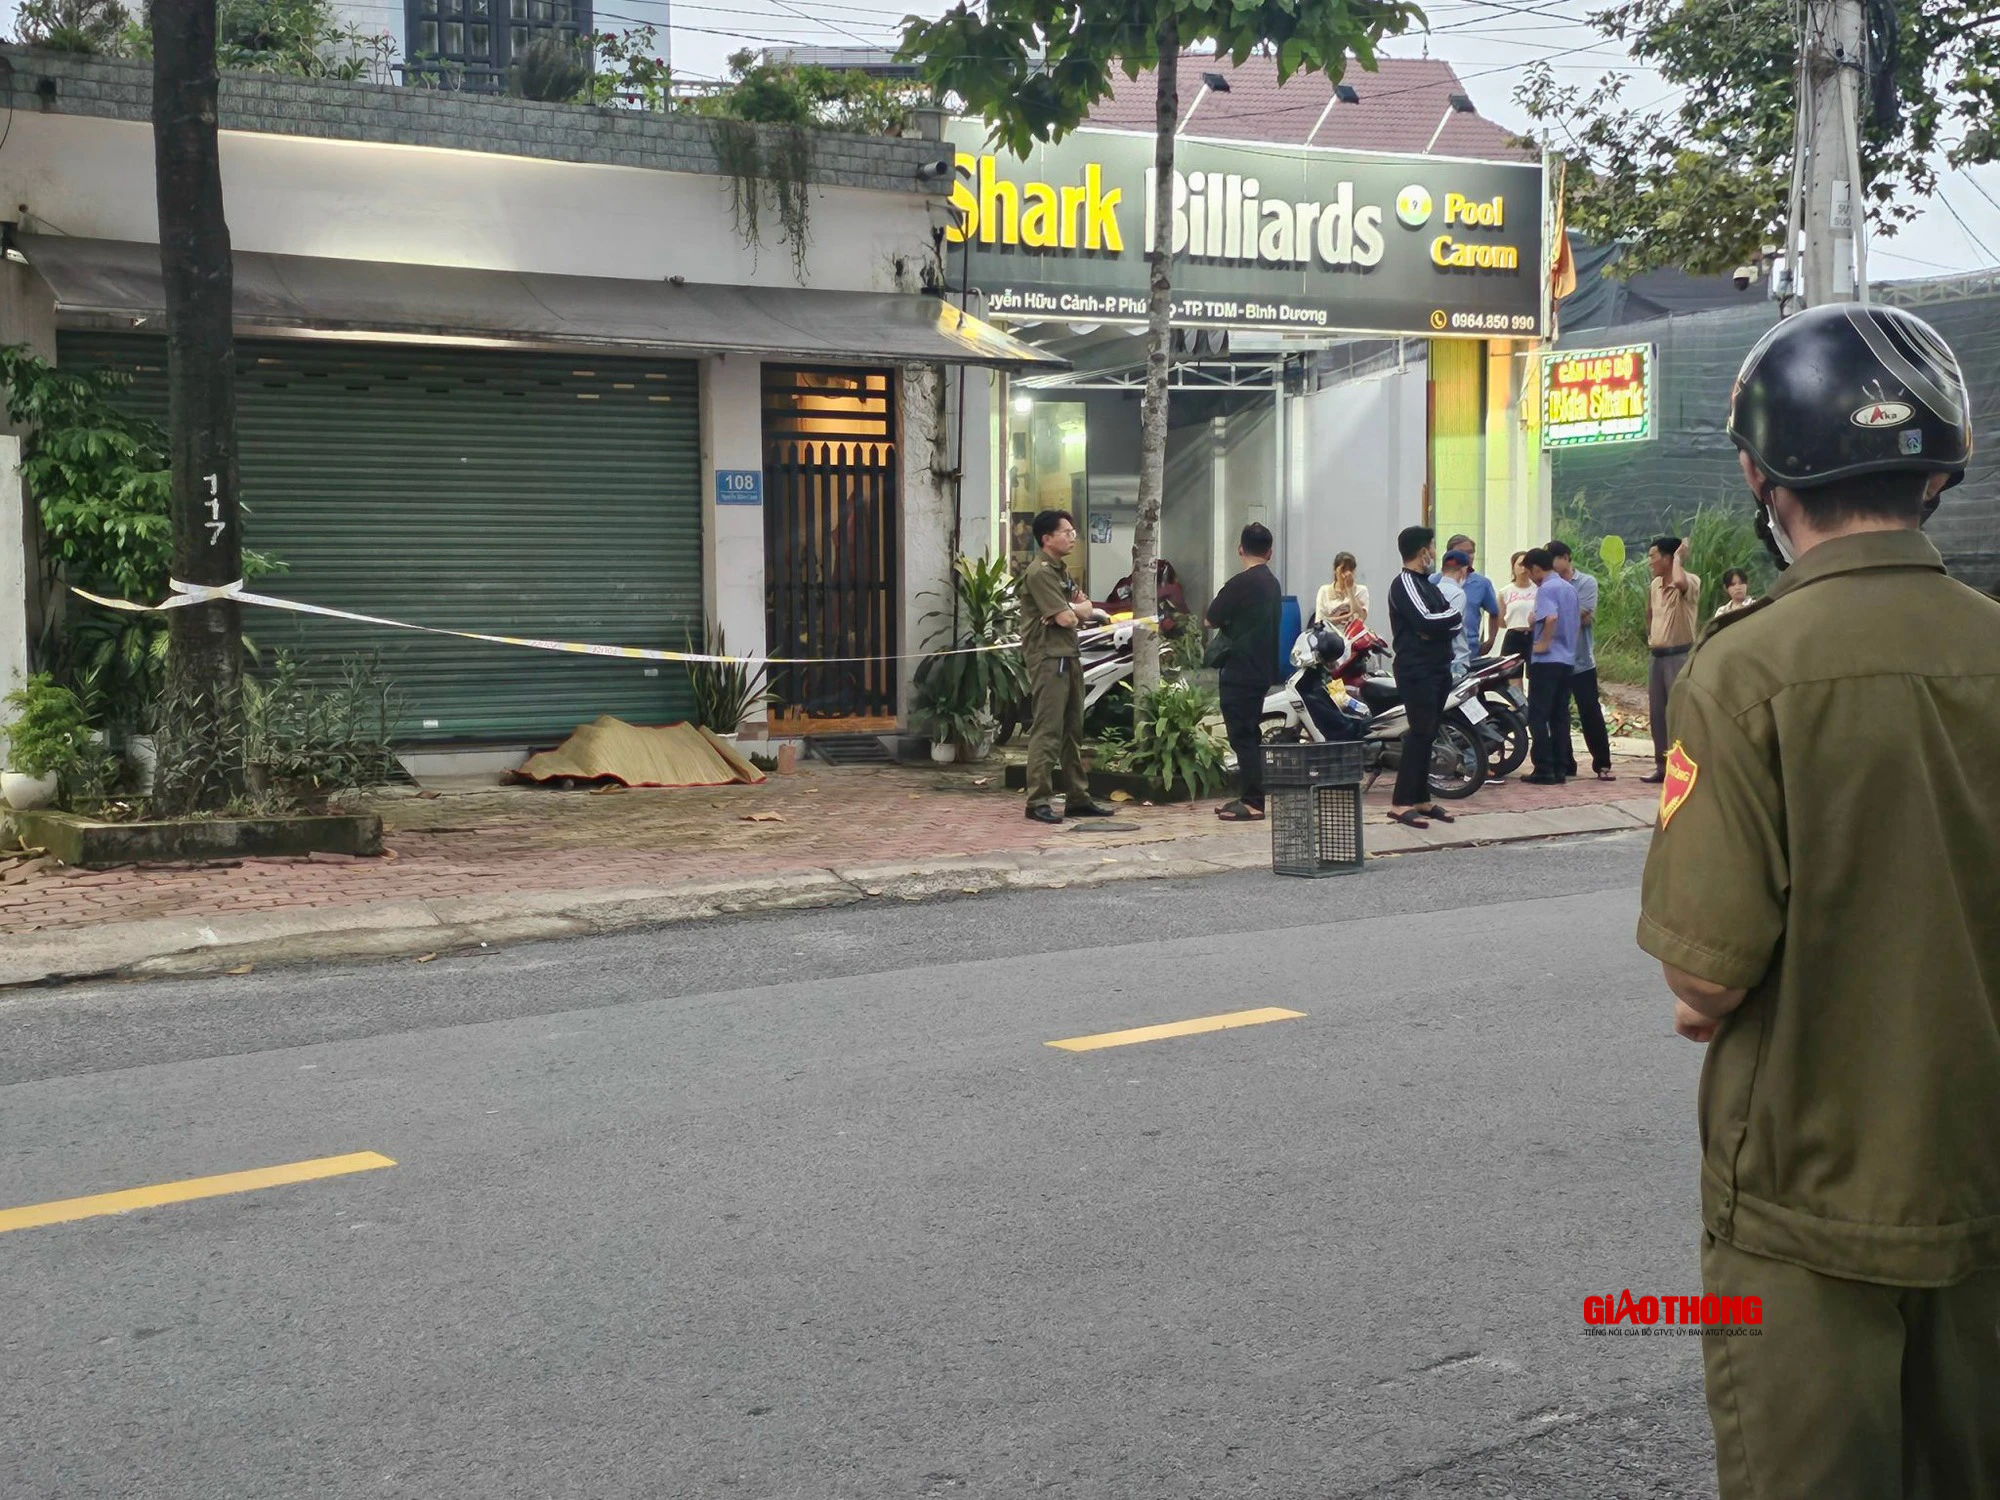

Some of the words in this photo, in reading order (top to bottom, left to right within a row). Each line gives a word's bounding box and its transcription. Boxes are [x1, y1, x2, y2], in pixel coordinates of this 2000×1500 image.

[946, 153, 1124, 251] Shark
[1145, 166, 1385, 267] Billiards
[1445, 193, 1503, 227] Pool
[1430, 235, 1518, 269] Carom
[1024, 292, 1057, 310] Hữu
[1118, 297, 1147, 314] Phú
[1279, 305, 1328, 325] Dương
[1451, 312, 1509, 329] 0964.850
[1511, 315, 1535, 330] 990
[1590, 381, 1644, 420] Shark
[725, 474, 755, 490] 108
